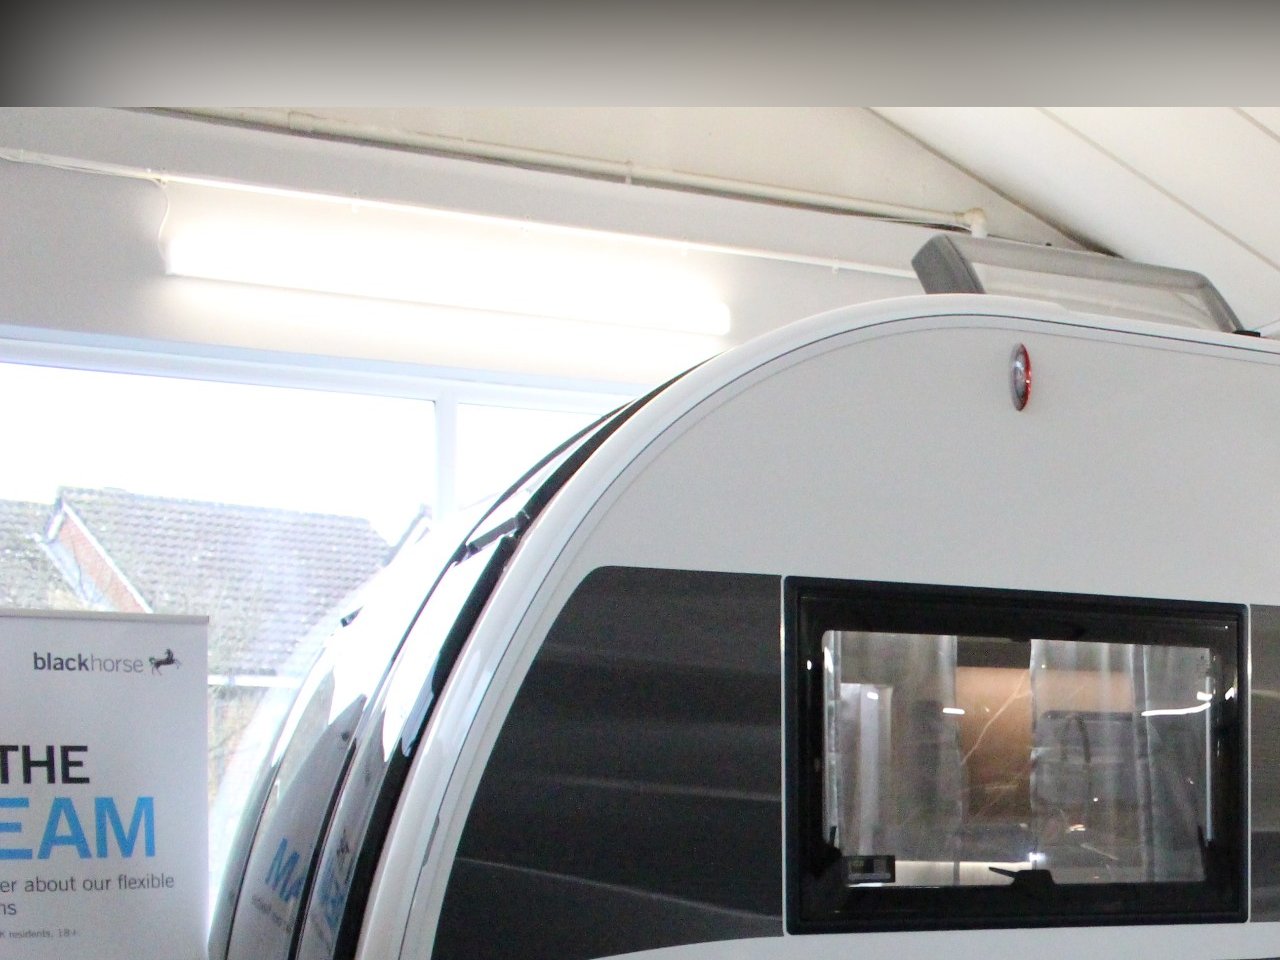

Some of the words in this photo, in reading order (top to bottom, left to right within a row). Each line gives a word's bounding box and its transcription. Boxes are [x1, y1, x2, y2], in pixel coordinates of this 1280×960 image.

[33, 651, 144, 673] blackhorse
[0, 745, 90, 784] THE
[0, 796, 156, 860] EAM
[24, 876, 77, 893] about
[82, 877, 112, 892] our
[118, 873, 175, 891] flexible
